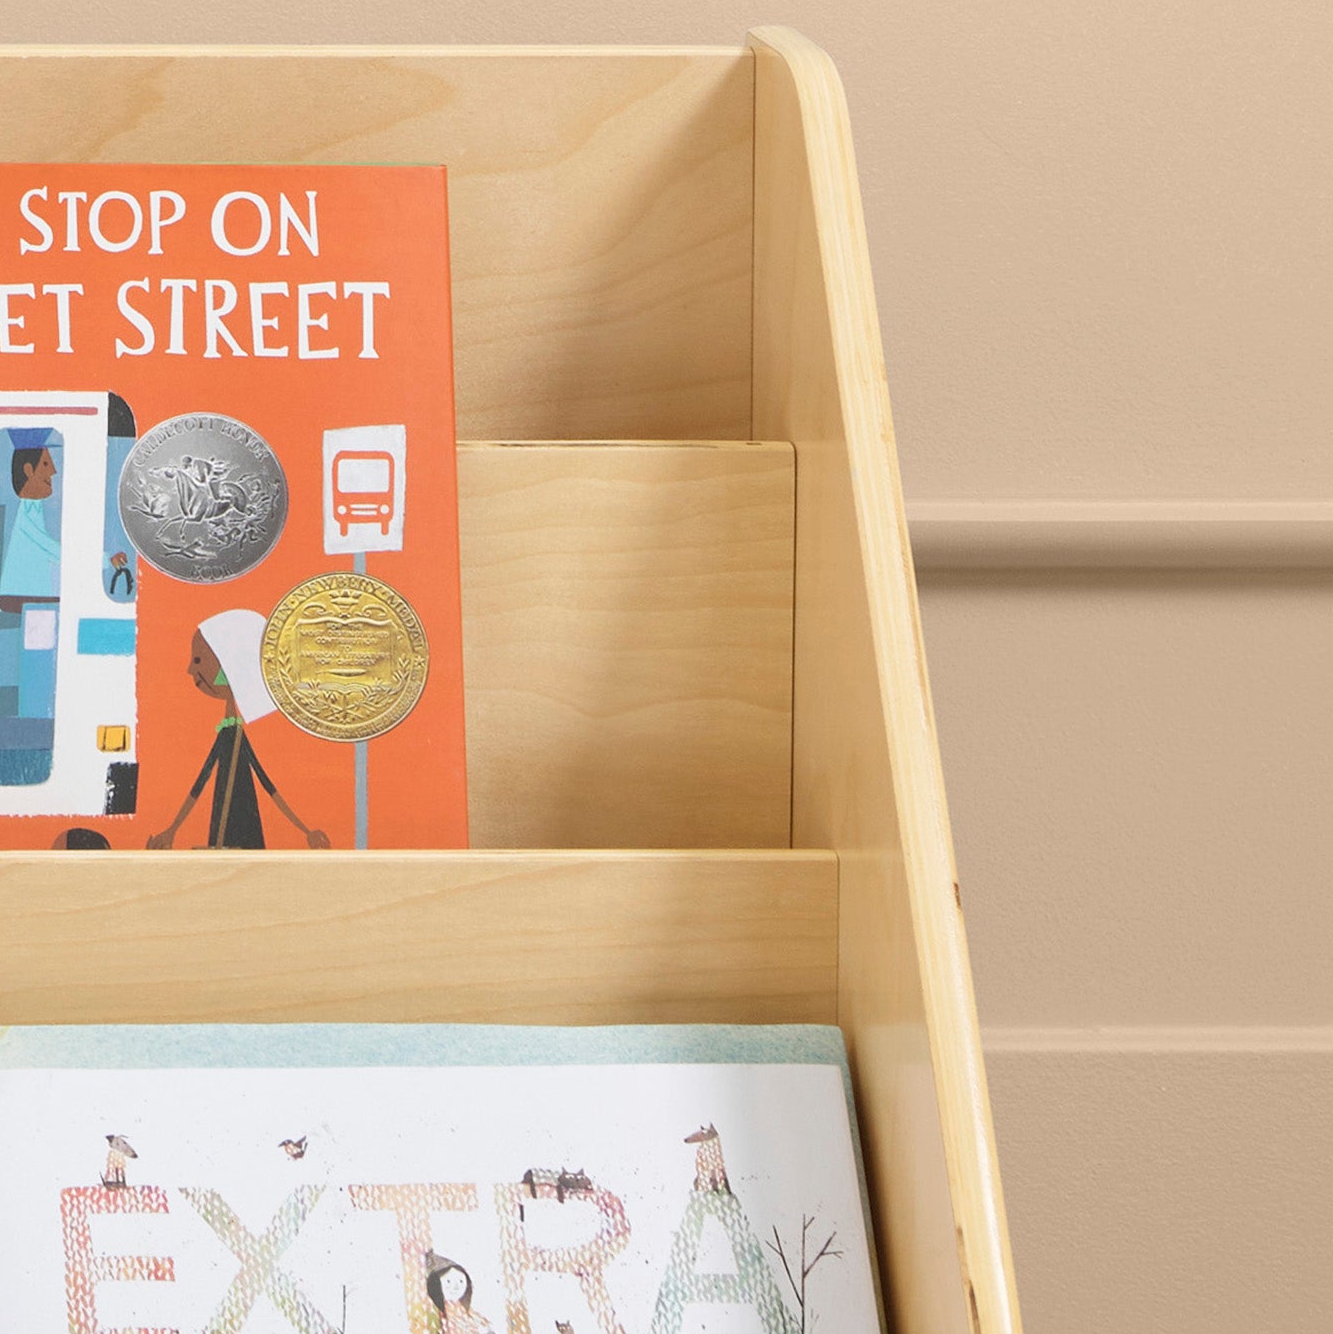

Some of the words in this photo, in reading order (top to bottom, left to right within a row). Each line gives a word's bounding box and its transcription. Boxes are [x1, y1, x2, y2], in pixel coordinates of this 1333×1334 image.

[19, 186, 188, 257] STOP
[210, 191, 321, 258] ON
[114, 277, 392, 361] STREET
[133, 417, 216, 467] CALDECOTT
[220, 421, 271, 463] HONOR
